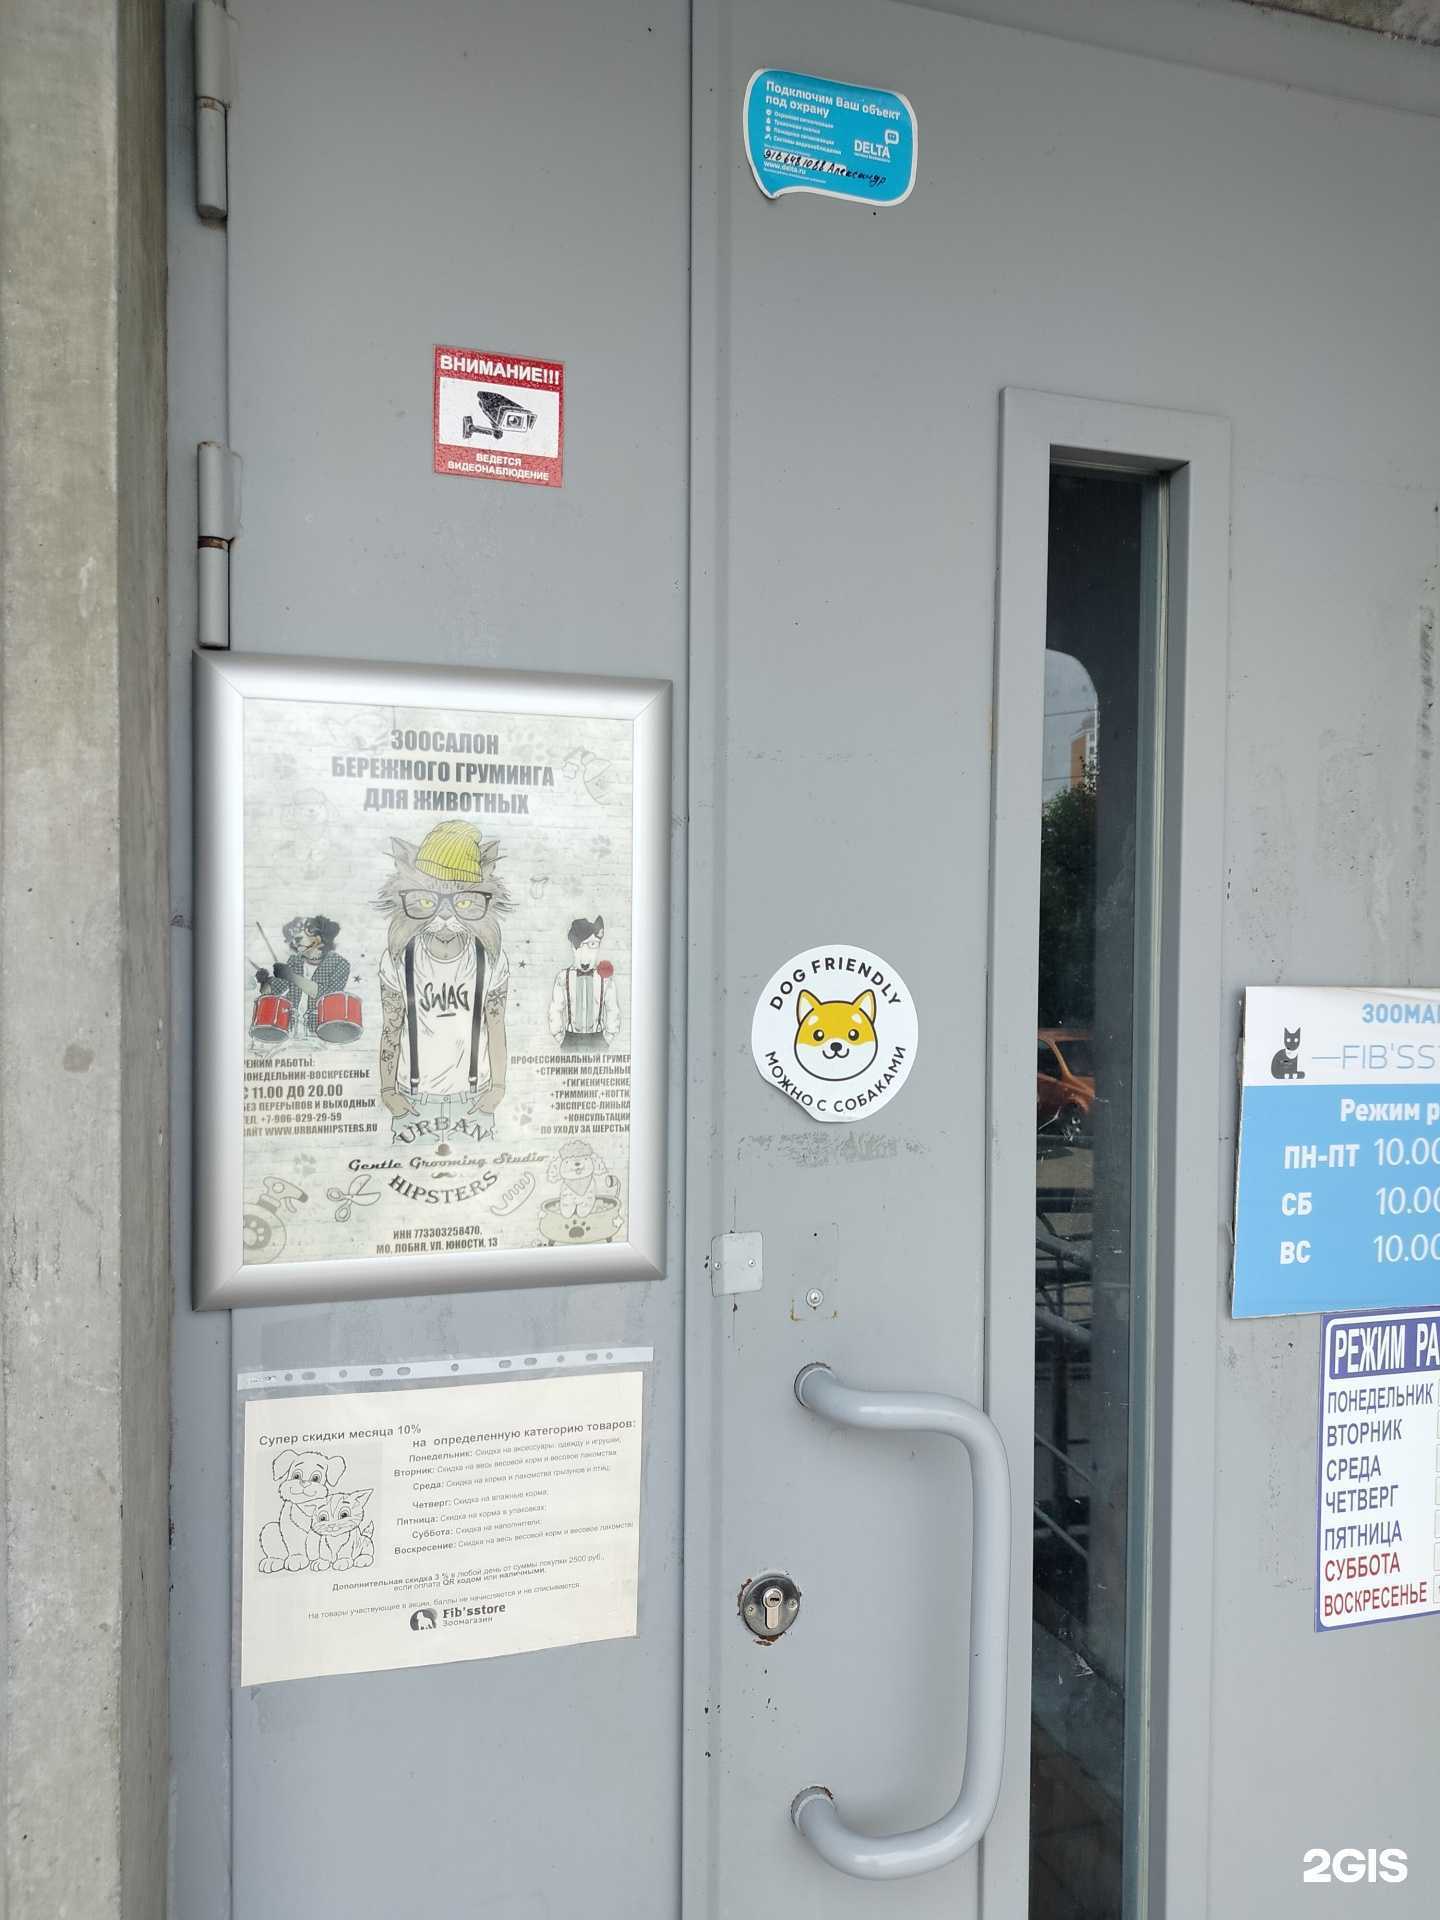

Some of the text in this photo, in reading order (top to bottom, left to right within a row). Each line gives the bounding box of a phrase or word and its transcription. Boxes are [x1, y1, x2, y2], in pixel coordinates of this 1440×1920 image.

[766, 81, 901, 120] Подключим Ваш объект
[766, 95, 829, 119] под охрану
[854, 139, 890, 158] DELTA
[440, 354, 560, 385] ВНИМАНИЕ!!!
[448, 461, 550, 481] ВИДЕОНАБЛЮДЕНИЕ
[476, 453, 522, 466] ВЕДЕТСЯ
[390, 729, 499, 755] ЗООСАЛОН
[331, 756, 554, 787] БЕРЕЖНОГО ГРУМИНГА
[363, 788, 529, 815] ДЛЯ ЖИВОТНЫХ
[769, 956, 902, 1010] DOG FRIENDLY
[420, 981, 470, 1012] SWAG
[1362, 1003, 1440, 1024] ЗООМА
[244, 1059, 273, 1069] ЕЖИМ
[511, 1055, 601, 1065] ПРОФЕССИОНАЛЬНЫЙ
[1341, 1043, 1440, 1070] FIB'SS
[765, 1045, 906, 1113] МОЖНО С СОБАКАМИ
[252, 1086, 283, 1099] 11.00
[286, 1085, 305, 1100] ДО
[308, 1084, 343, 1098] 20.00
[244, 1102, 257, 1112] ЕЗ
[259, 1100, 313, 1112] ПЕРЕРЫВОВ
[322, 1098, 376, 1110] ВЫХОДНЫХ
[1340, 1098, 1420, 1122] Режим
[244, 1127, 263, 1137] АЙТ
[398, 1117, 489, 1144] URBAN
[540, 1125, 552, 1135] ПО
[554, 1125, 579, 1135] УХОДУ
[580, 1124, 591, 1133] ЗА
[348, 1152, 548, 1171] Gentle Grooming Studio
[1283, 1143, 1360, 1169] ПН-ПТ
[388, 1170, 498, 1205] HIPSTERS
[1281, 1191, 1312, 1216] СБ
[393, 1229, 412, 1240] ИНН
[488, 1237, 498, 1247] 13
[1279, 1240, 1312, 1265] ВС
[1334, 1322, 1440, 1374] РЕЖИМ РА
[1327, 1382, 1434, 1414] ПОНЕДЕЛЬНИК
[259, 1424, 421, 1448] Супер скидки месяца 10%
[412, 1419, 637, 1448] на определенную категорию товаров:
[1326, 1418, 1402, 1447] ВТОРНИК
[409, 1450, 473, 1463] Понедельник:
[1326, 1454, 1382, 1483] СРЕДА
[394, 1467, 435, 1478] Вторник:
[413, 1482, 444, 1491] Среда:
[413, 1499, 452, 1509] Четверг:
[1325, 1484, 1399, 1514] ЧЕТВЕРГ
[397, 1515, 439, 1526] Пятница:
[412, 1528, 453, 1540] Суббота:
[1324, 1520, 1402, 1551] ПЯТНИЦА
[1324, 1551, 1400, 1582] СУББОТА
[332, 1578, 404, 1592] Дополнительная
[405, 1575, 433, 1584] скидка
[457, 1568, 482, 1578] любой
[1323, 1581, 1428, 1617] ВОСКРЕСЕНЬЕ
